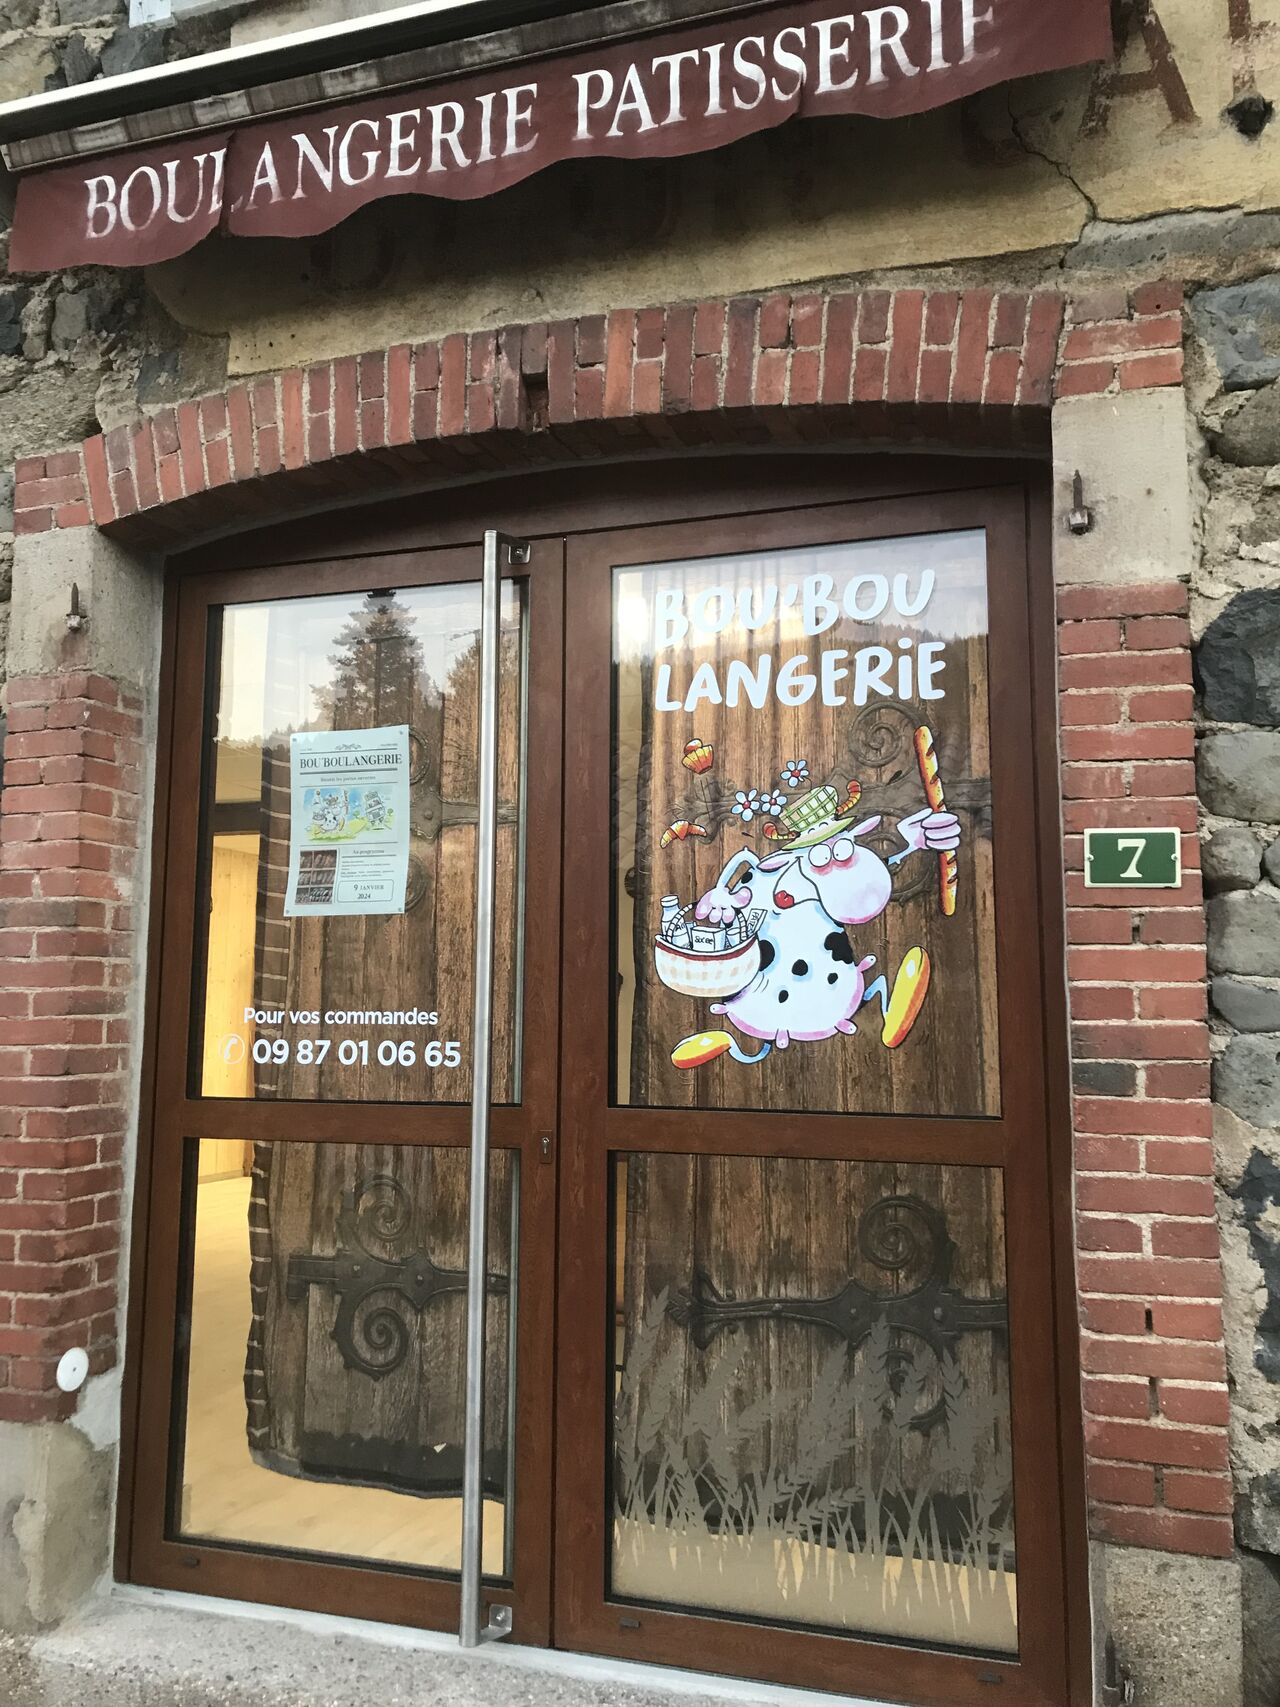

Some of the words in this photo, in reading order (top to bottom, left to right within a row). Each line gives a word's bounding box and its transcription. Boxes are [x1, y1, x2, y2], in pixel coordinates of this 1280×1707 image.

[84, 82, 540, 239] BOULANGERIE
[572, 0, 1001, 141] PATISSERIE
[654, 568, 936, 651] BOU'BOU
[1117, 838, 1147, 878] 7
[353, 883, 359, 892] 9
[360, 884, 385, 892] JANVIER
[357, 893, 371, 901] 2024
[243, 1007, 285, 1025] Pour
[290, 1011, 321, 1025] vos
[324, 1007, 439, 1026] commandes
[252, 1038, 290, 1066] 09
[296, 1039, 331, 1066] 87
[338, 1040, 369, 1067] 01
[377, 1040, 417, 1068] 06
[424, 1041, 462, 1069] 65
